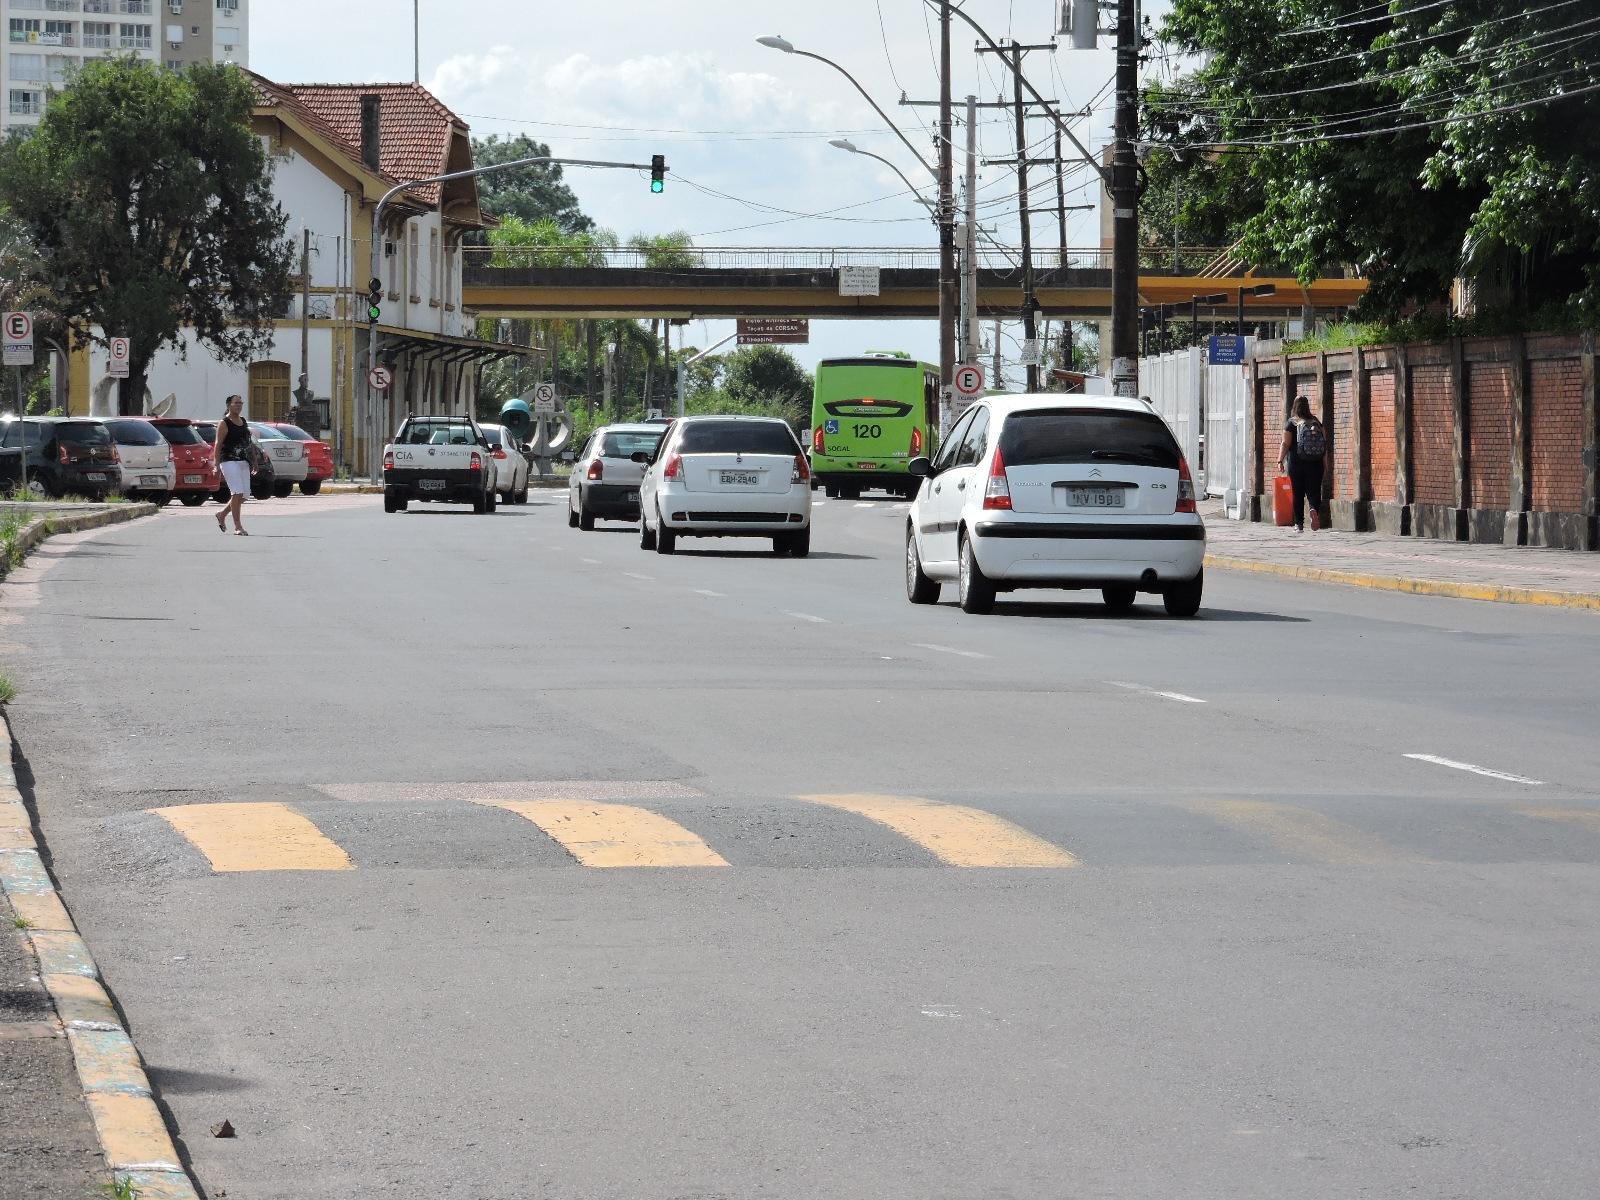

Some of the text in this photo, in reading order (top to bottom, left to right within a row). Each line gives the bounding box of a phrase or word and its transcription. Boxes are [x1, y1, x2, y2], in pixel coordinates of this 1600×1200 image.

[12, 317, 23, 334] E
[116, 343, 122, 355] E
[964, 373, 972, 387] E
[852, 424, 882, 439] 120
